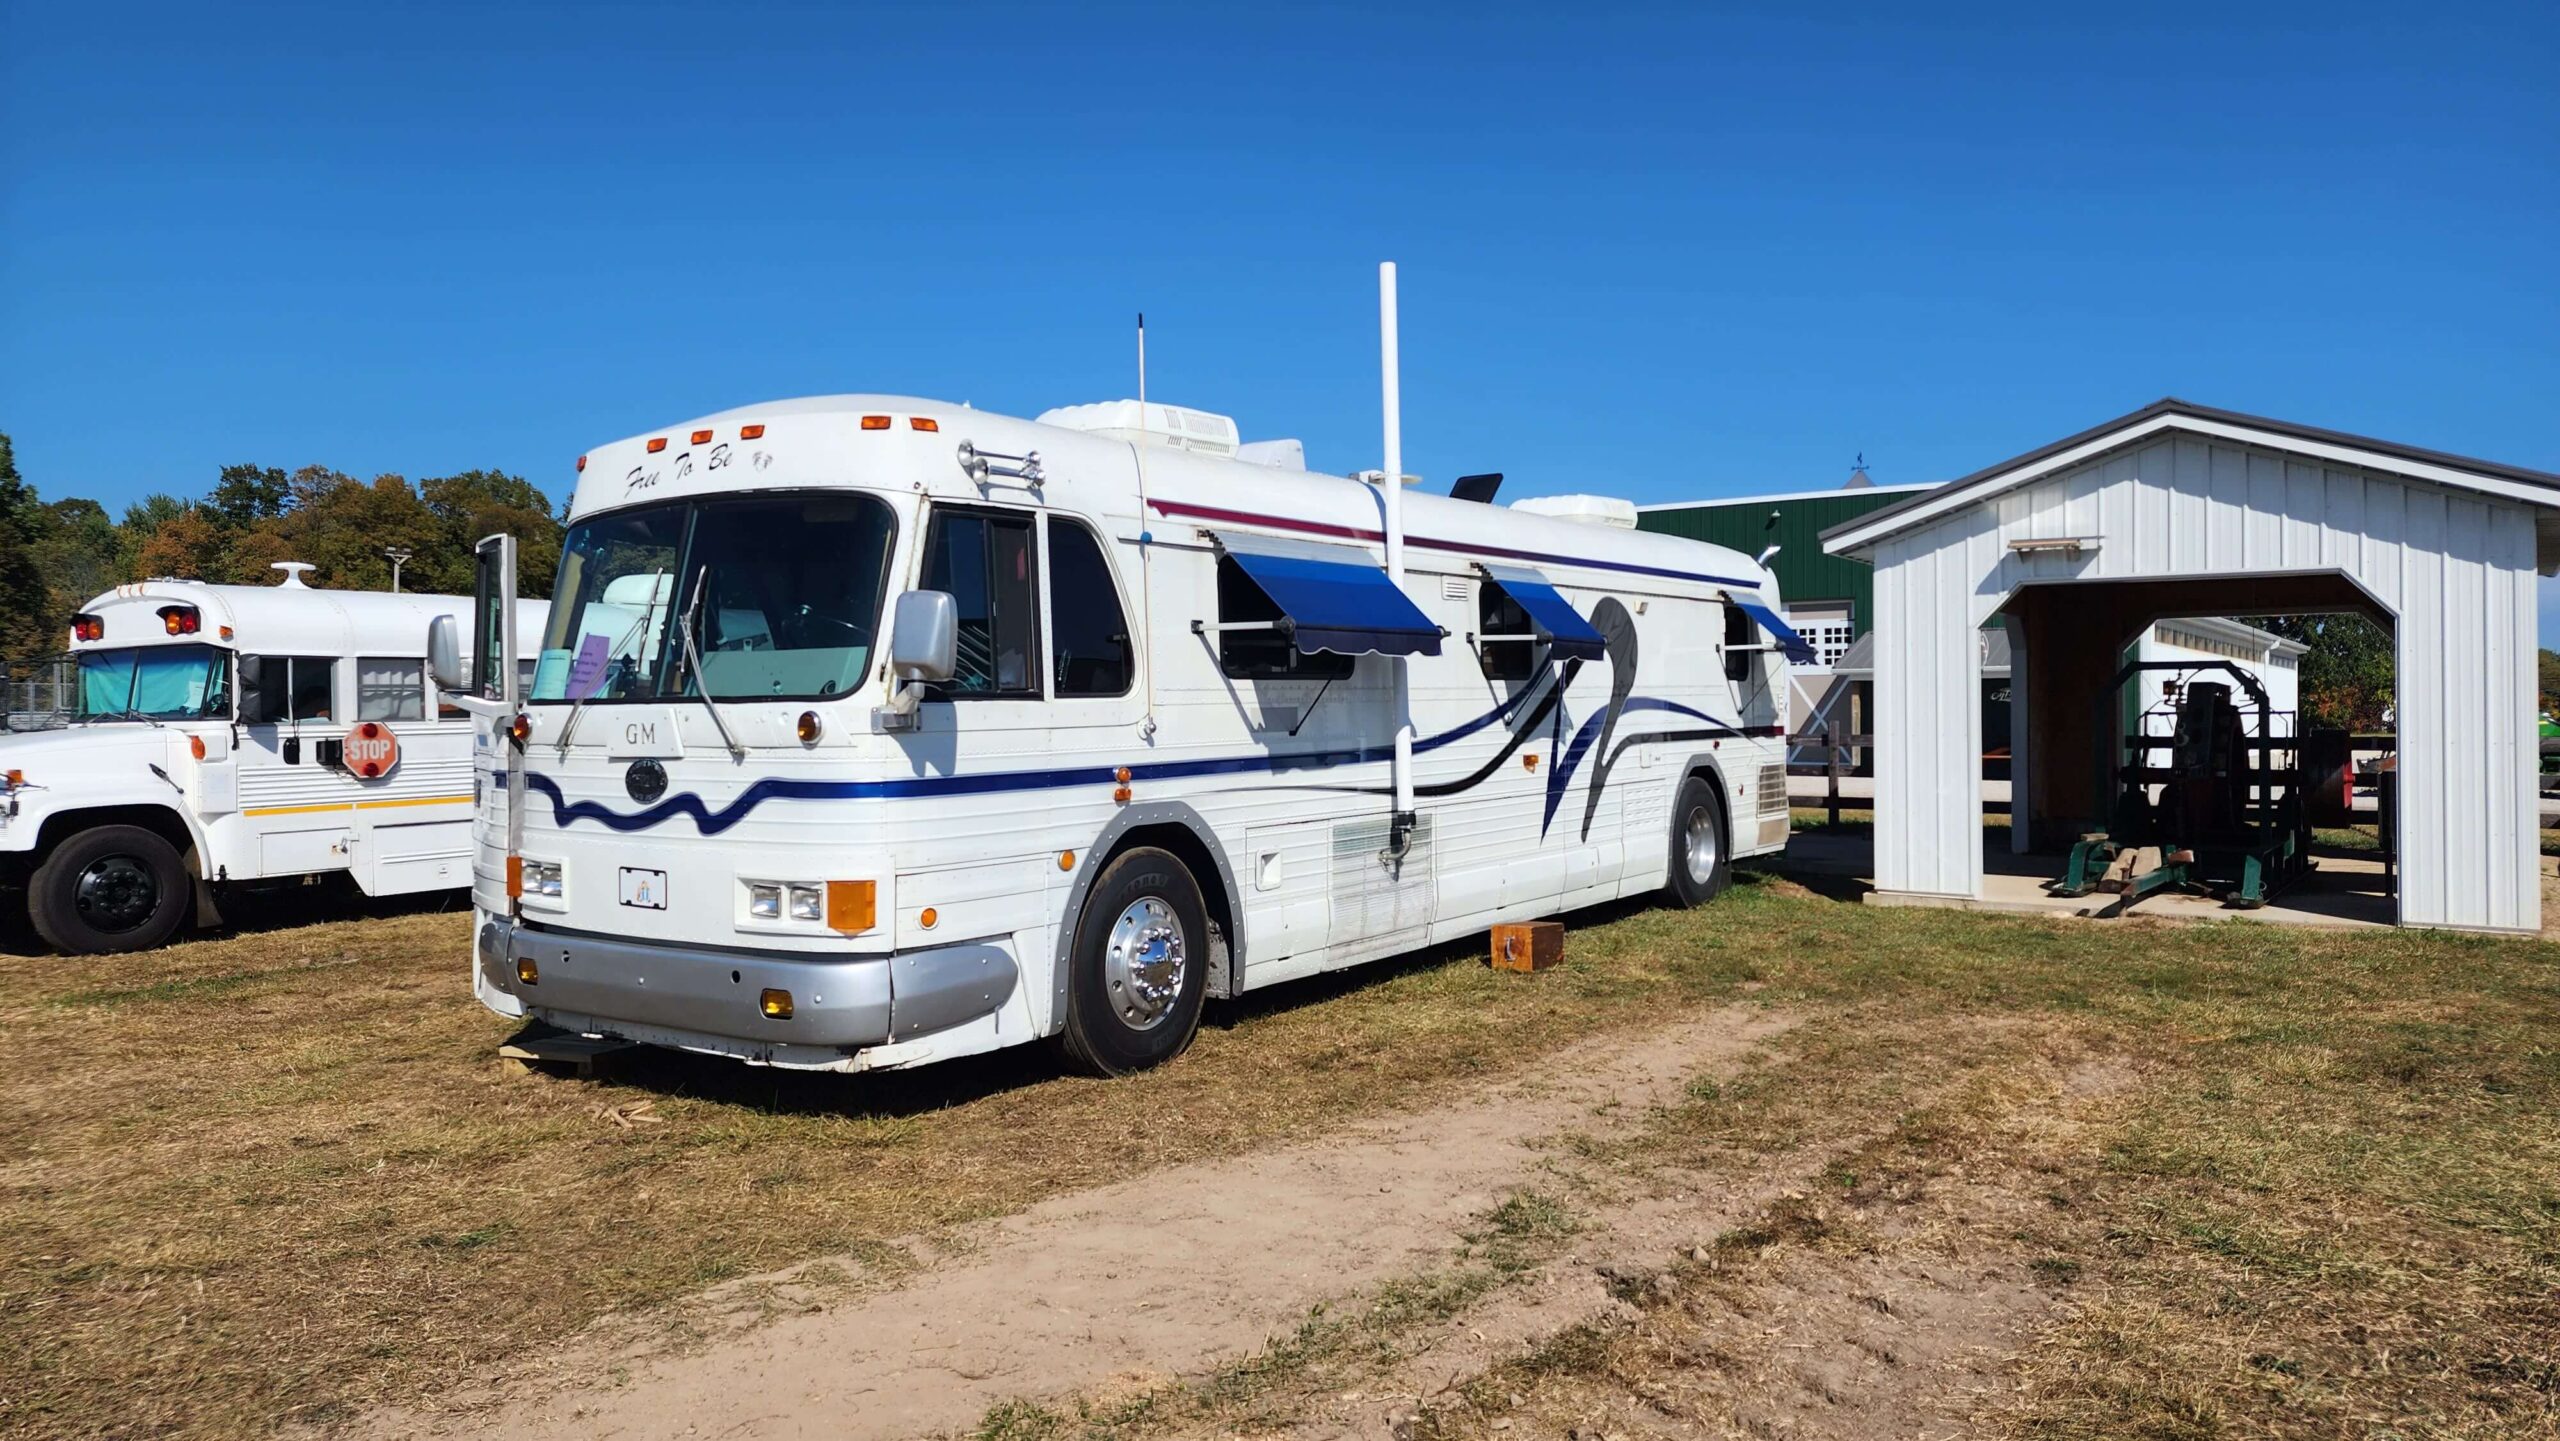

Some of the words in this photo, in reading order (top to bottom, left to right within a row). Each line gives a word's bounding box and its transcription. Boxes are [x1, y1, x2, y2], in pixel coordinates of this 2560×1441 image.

[624, 465, 660, 498] Free
[674, 452, 695, 480] To
[709, 443, 733, 471] Be
[626, 723, 656, 745] GM
[351, 739, 391, 760] STOP
